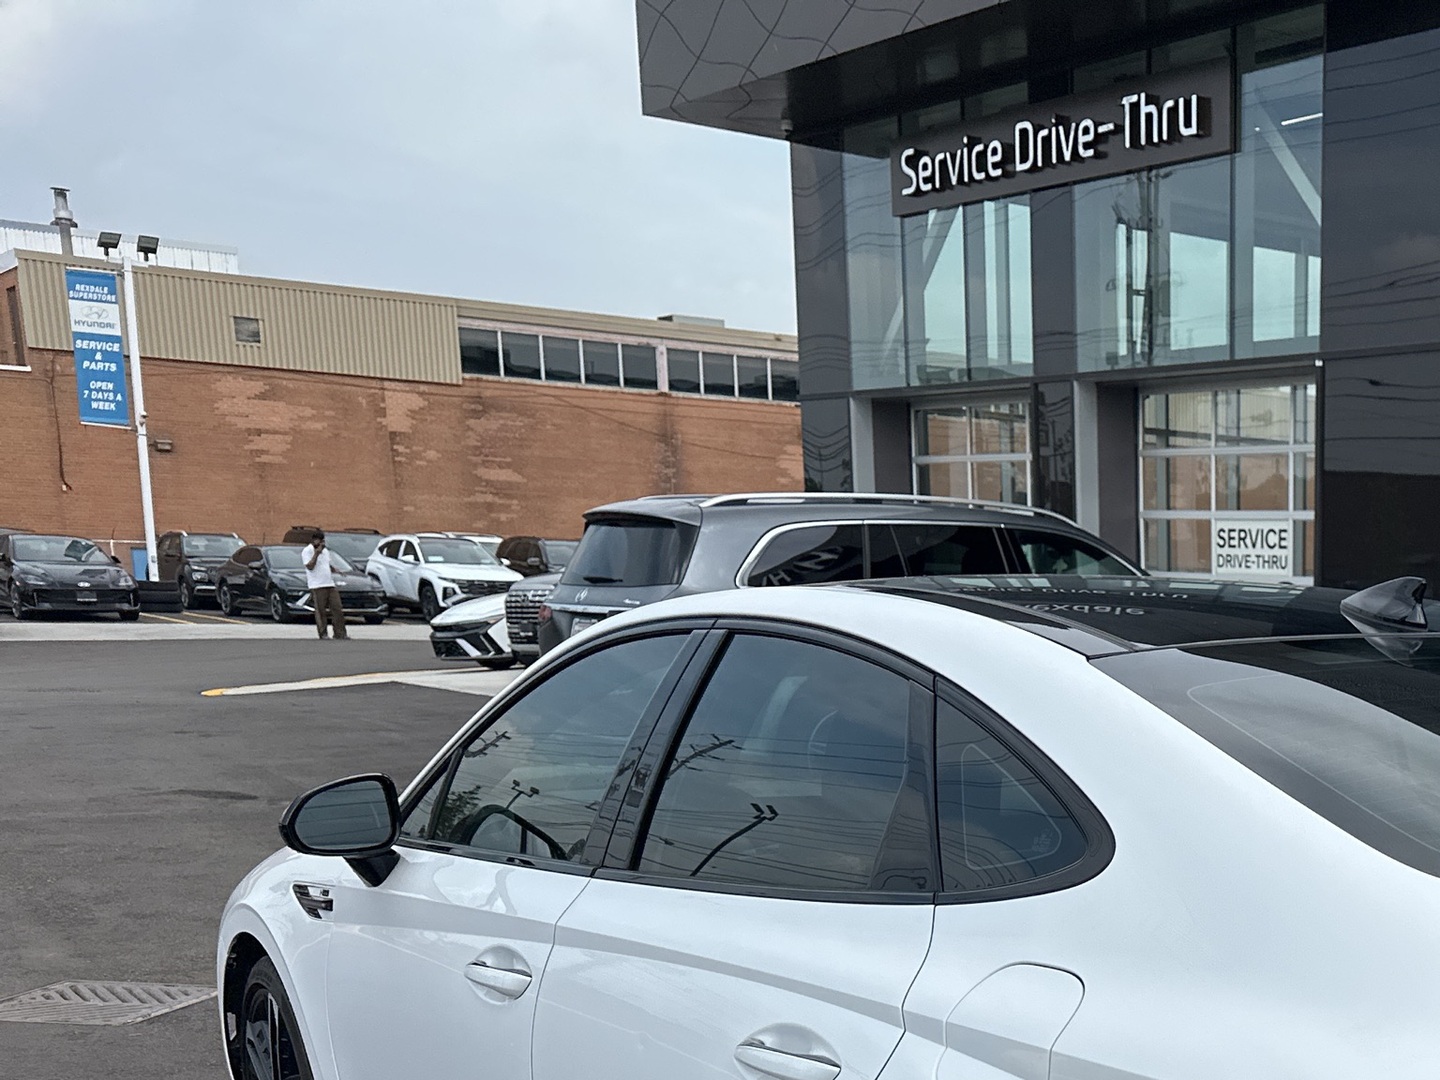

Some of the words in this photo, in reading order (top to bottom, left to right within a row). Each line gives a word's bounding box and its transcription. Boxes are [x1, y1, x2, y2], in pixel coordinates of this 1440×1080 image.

[901, 135, 1003, 196] Service
[1013, 92, 1198, 172] Drive-Thru
[75, 283, 109, 294] REXDALE
[69, 290, 117, 302] SUPERSTORE
[74, 319, 115, 329] HYUNDAI
[75, 339, 120, 352] SERVICE
[94, 351, 103, 361] &
[82, 360, 117, 372] PARTS
[89, 380, 114, 390] OPEN
[83, 390, 90, 398] 7
[91, 391, 114, 401] DAYS
[115, 392, 122, 401] A
[91, 400, 117, 411] WEEK
[1216, 528, 1288, 549] SERVICE
[1216, 554, 1288, 570] DRIVE-THRU
